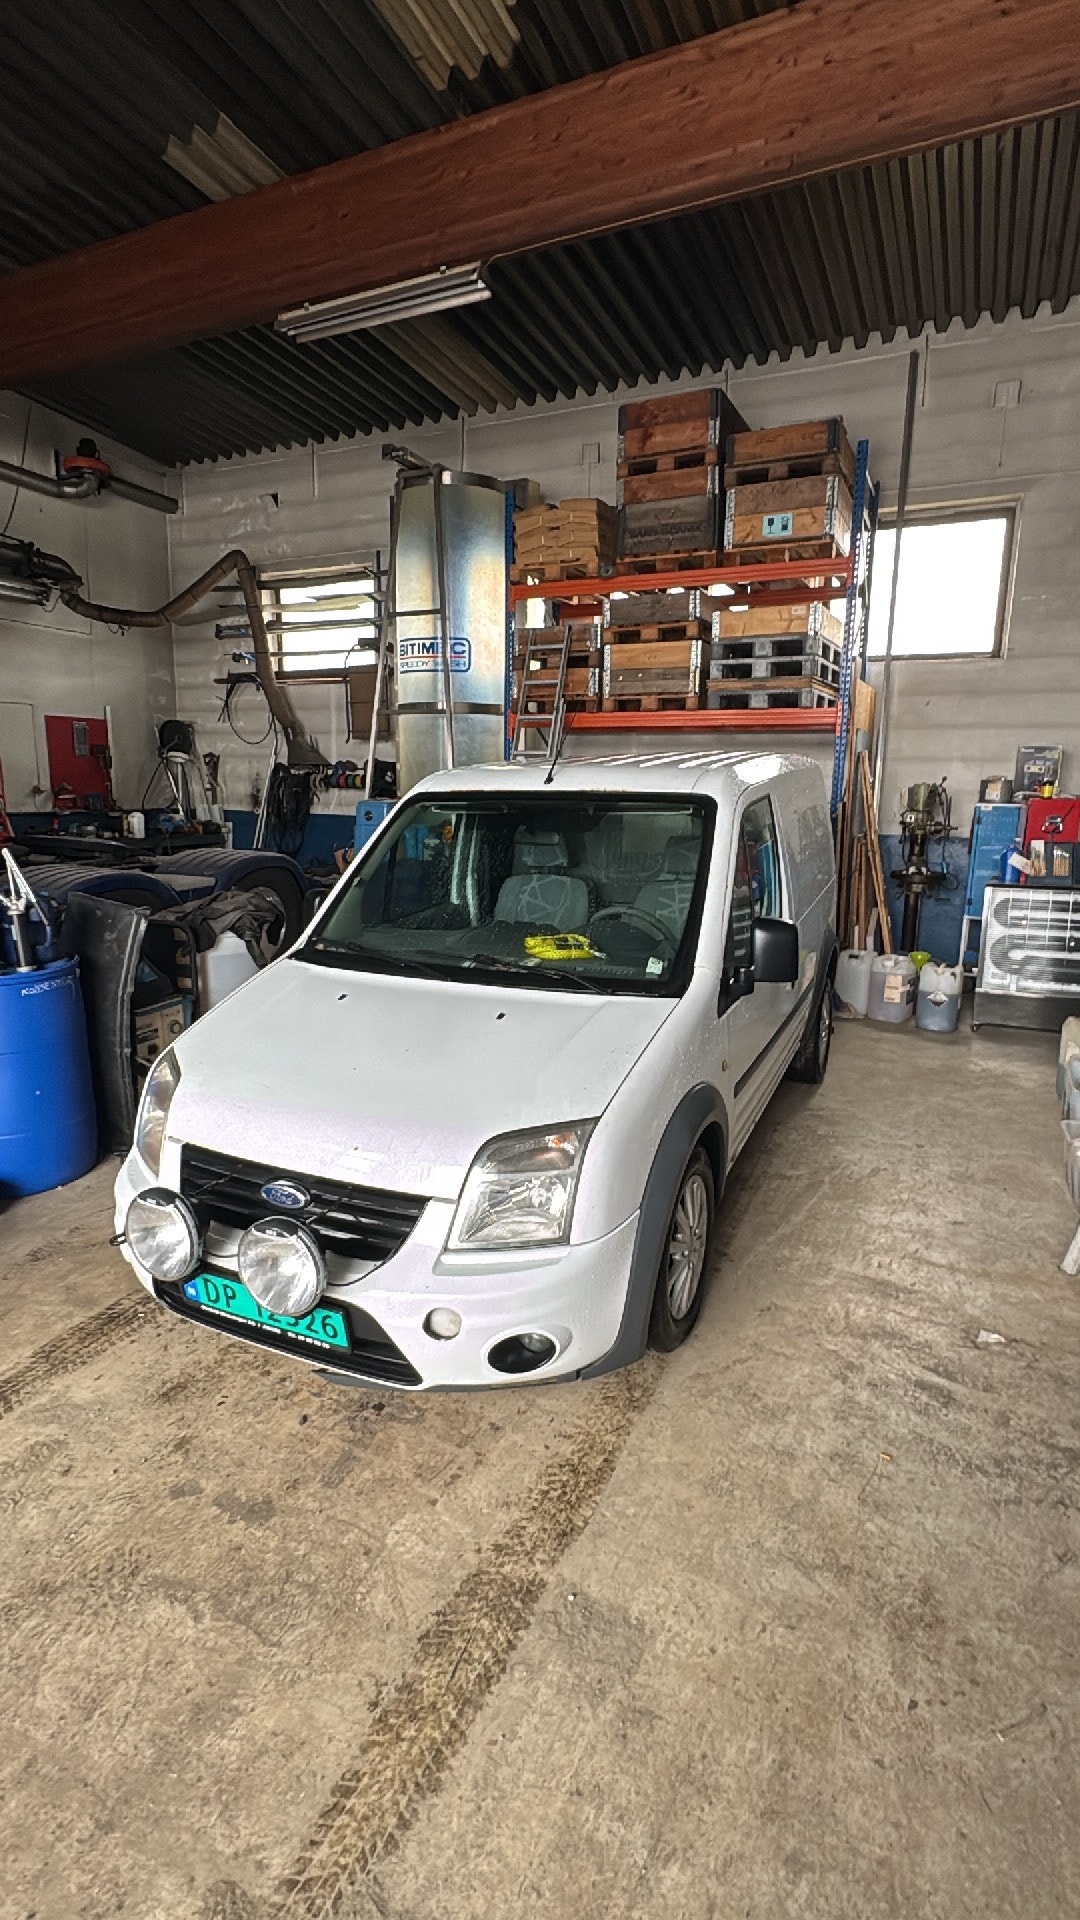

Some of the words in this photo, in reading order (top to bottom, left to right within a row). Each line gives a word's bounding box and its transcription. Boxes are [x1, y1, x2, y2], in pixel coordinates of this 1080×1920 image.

[400, 642, 466, 656] BITIMC
[271, 1188, 297, 1205] Ford
[202, 1277, 237, 1308] DP
